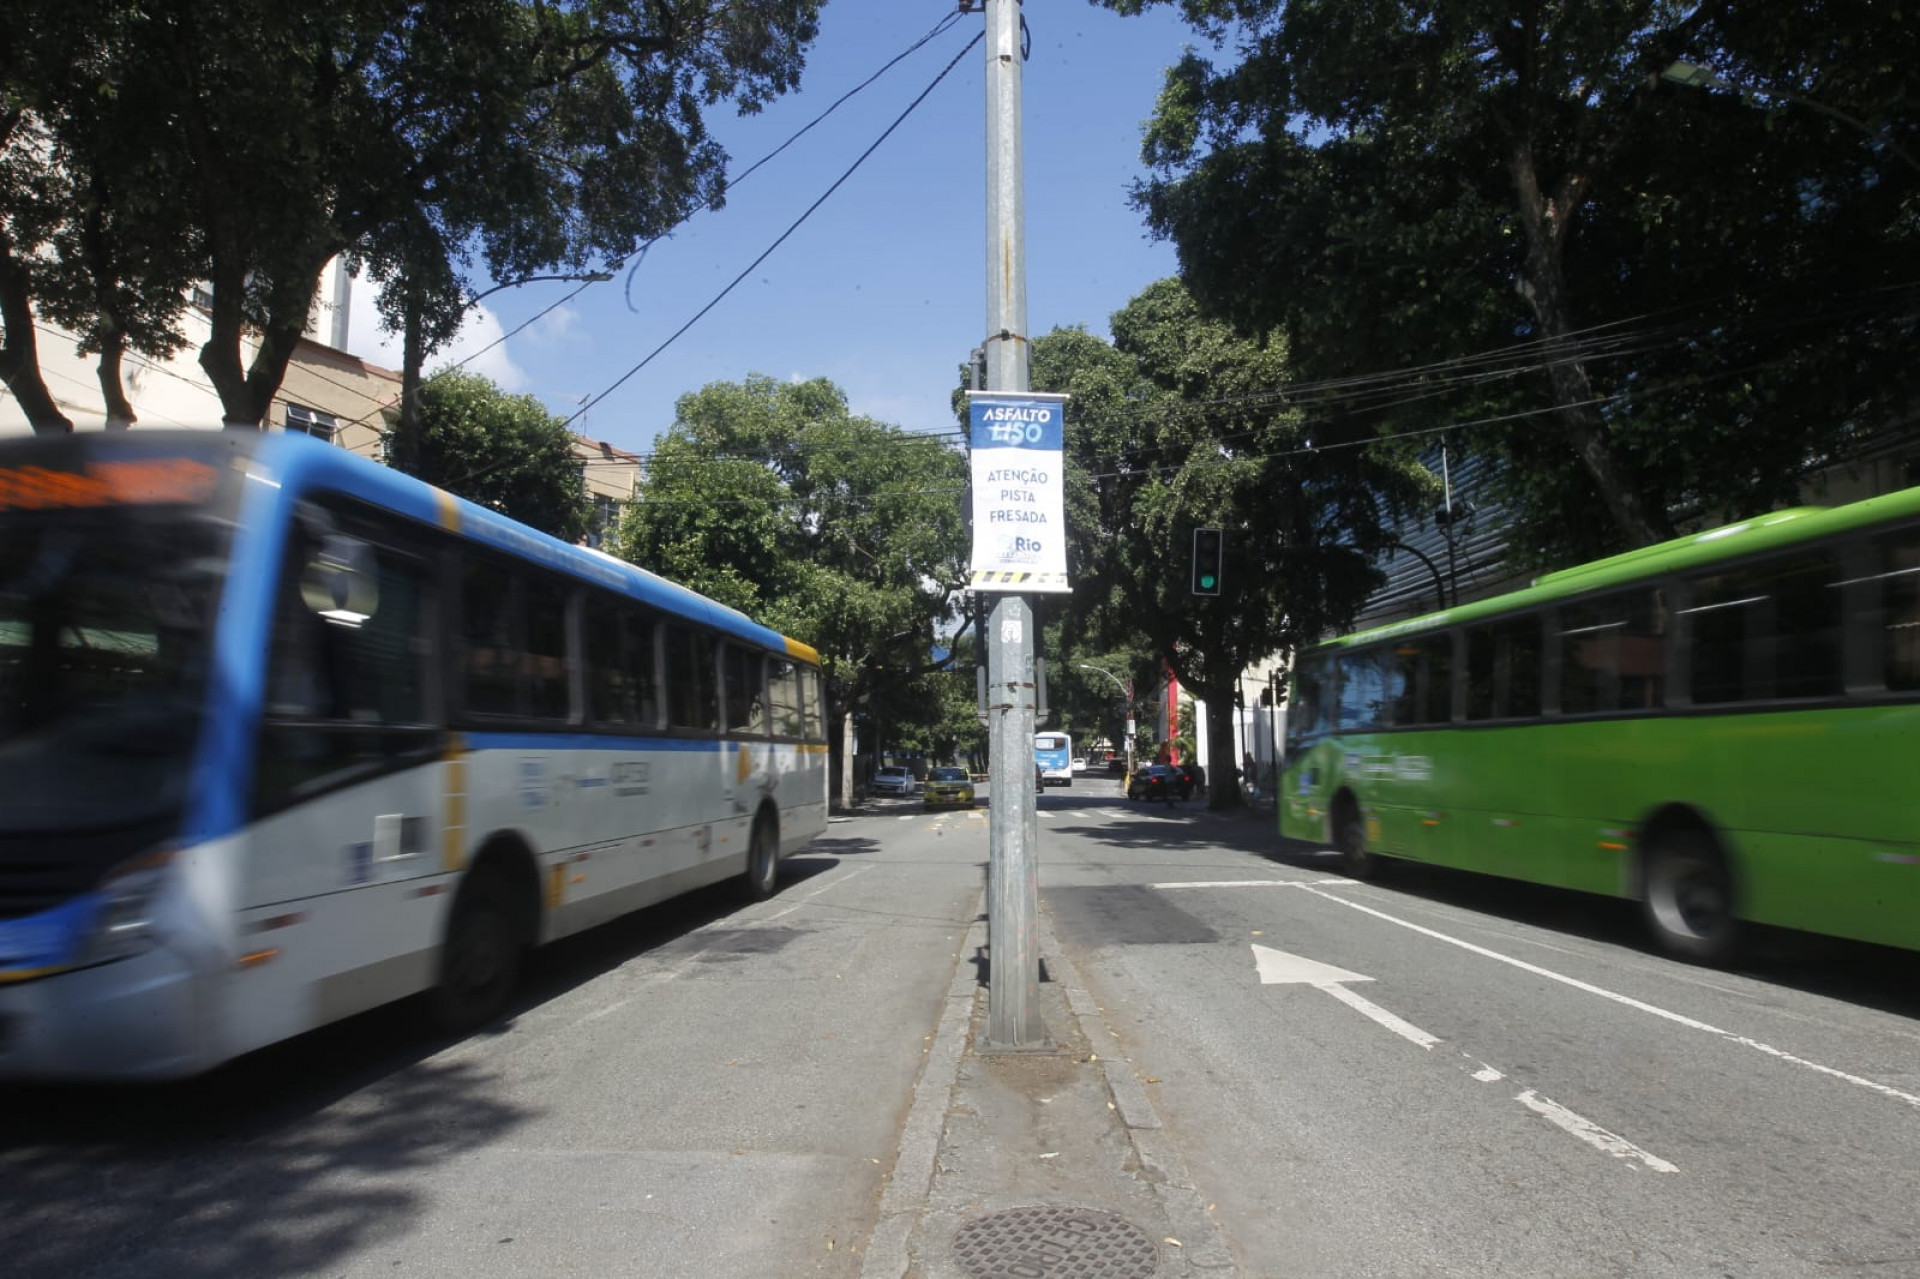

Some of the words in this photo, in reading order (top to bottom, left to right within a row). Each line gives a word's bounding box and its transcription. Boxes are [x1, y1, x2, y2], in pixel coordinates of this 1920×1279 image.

[983, 407, 1051, 423] ASFALTO
[988, 468, 1048, 485] ATENÇÃO
[1001, 490, 1036, 503] PISTA
[990, 510, 1047, 524] FRESADA
[1015, 537, 1042, 552] Rio
